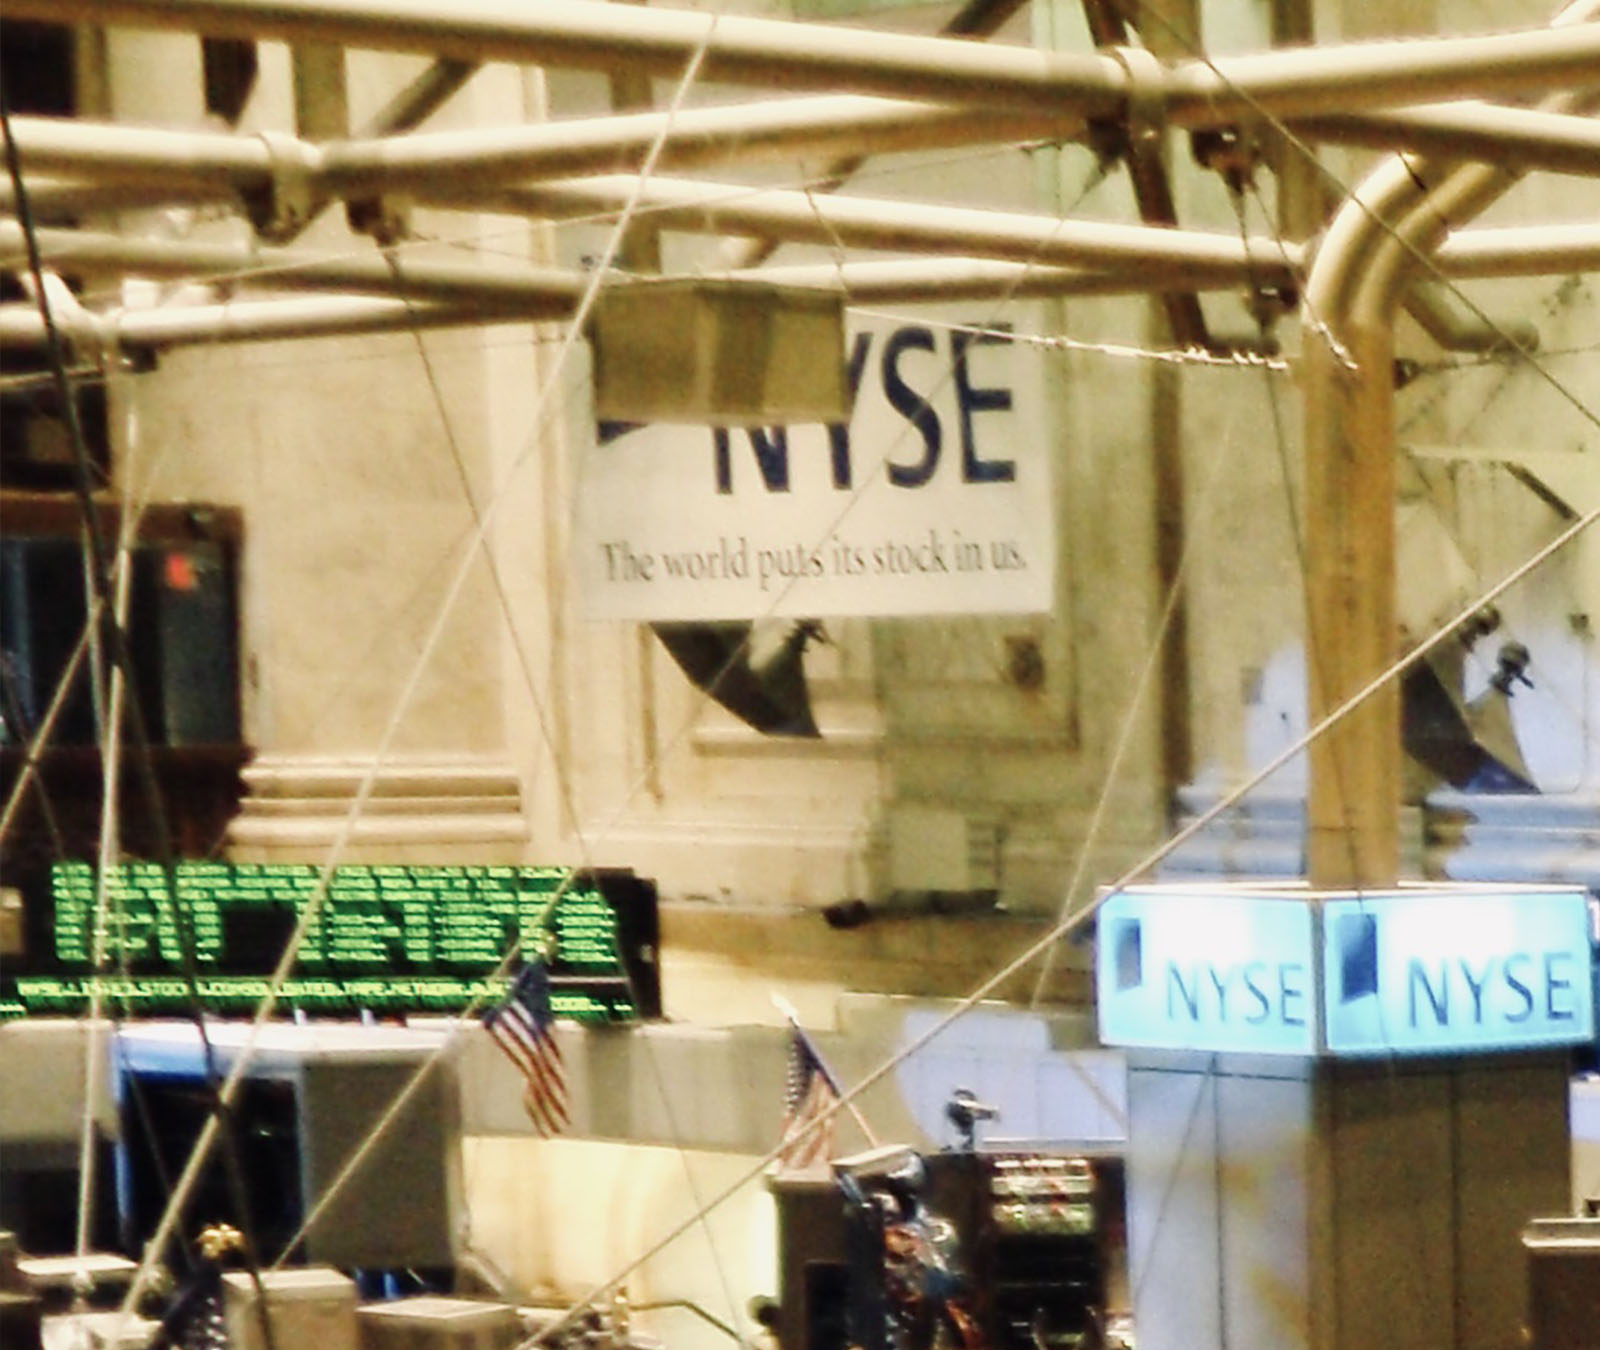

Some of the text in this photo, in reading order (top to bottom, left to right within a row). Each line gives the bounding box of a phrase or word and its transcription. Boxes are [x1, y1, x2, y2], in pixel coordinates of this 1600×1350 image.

[603, 529, 1028, 592] The world puts its stock in us.
[1167, 959, 1307, 1026] NYSE
[1407, 950, 1575, 1028] NYSE
